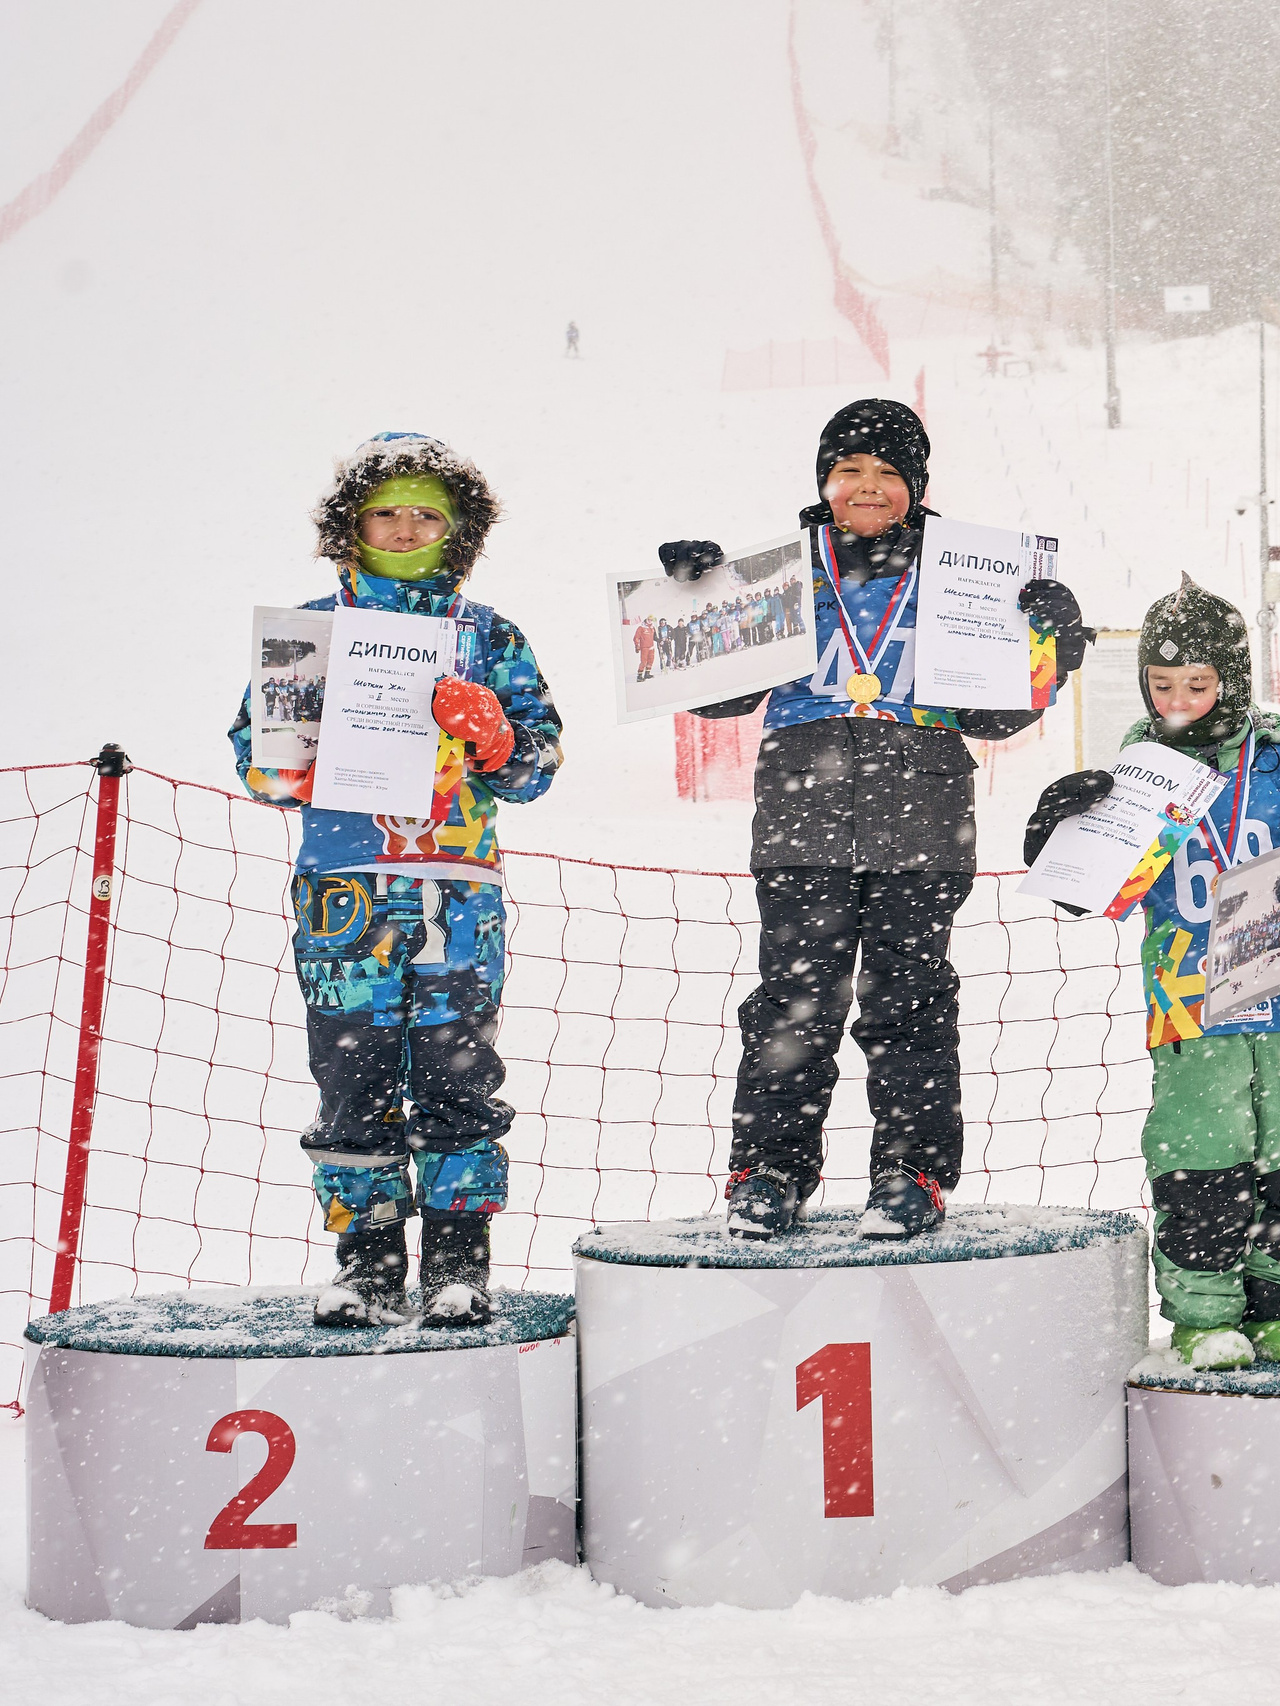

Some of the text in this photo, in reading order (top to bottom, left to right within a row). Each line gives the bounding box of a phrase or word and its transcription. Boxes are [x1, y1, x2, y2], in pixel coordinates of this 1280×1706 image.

[939, 551, 1020, 576] ДИПЛОМ
[957, 576, 1001, 588] НАГРАЖДАЕТСЯ
[348, 640, 438, 664] ДИПЛОМ
[1109, 763, 1180, 793] ДИПЛОМ
[795, 1342, 875, 1519] 1
[204, 1409, 297, 1549] 2
